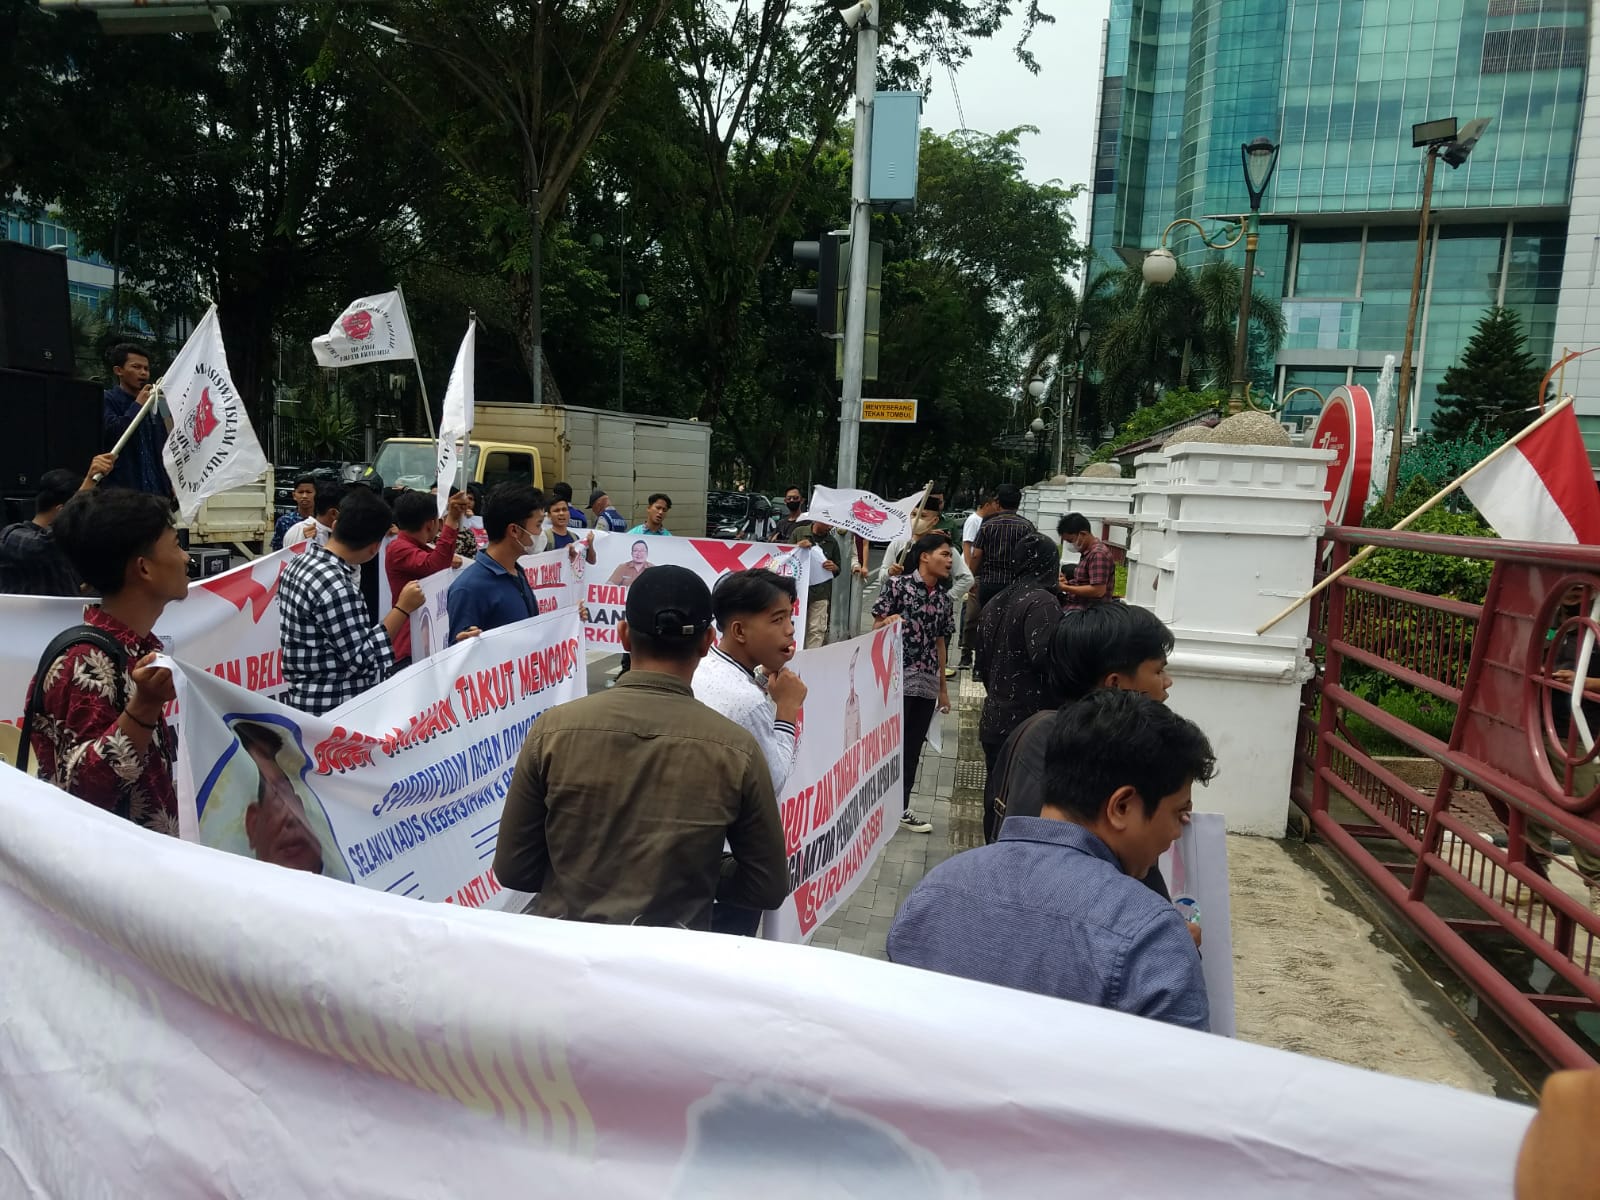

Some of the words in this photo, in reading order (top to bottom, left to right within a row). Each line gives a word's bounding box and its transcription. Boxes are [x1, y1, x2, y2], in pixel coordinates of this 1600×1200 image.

[221, 405, 238, 446] ISLAM
[455, 661, 516, 725] TAKUT
[468, 733, 503, 782] IRSAN
[348, 831, 393, 877] SELAKU
[390, 814, 426, 855] KADIS
[421, 777, 498, 838] KEBERSIHAN
[813, 769, 834, 831] DAN
[801, 826, 836, 884] AKTOR
[803, 836, 863, 924] SURUHAN
[861, 803, 885, 861] BOBBY
[456, 874, 490, 908] ANTI
